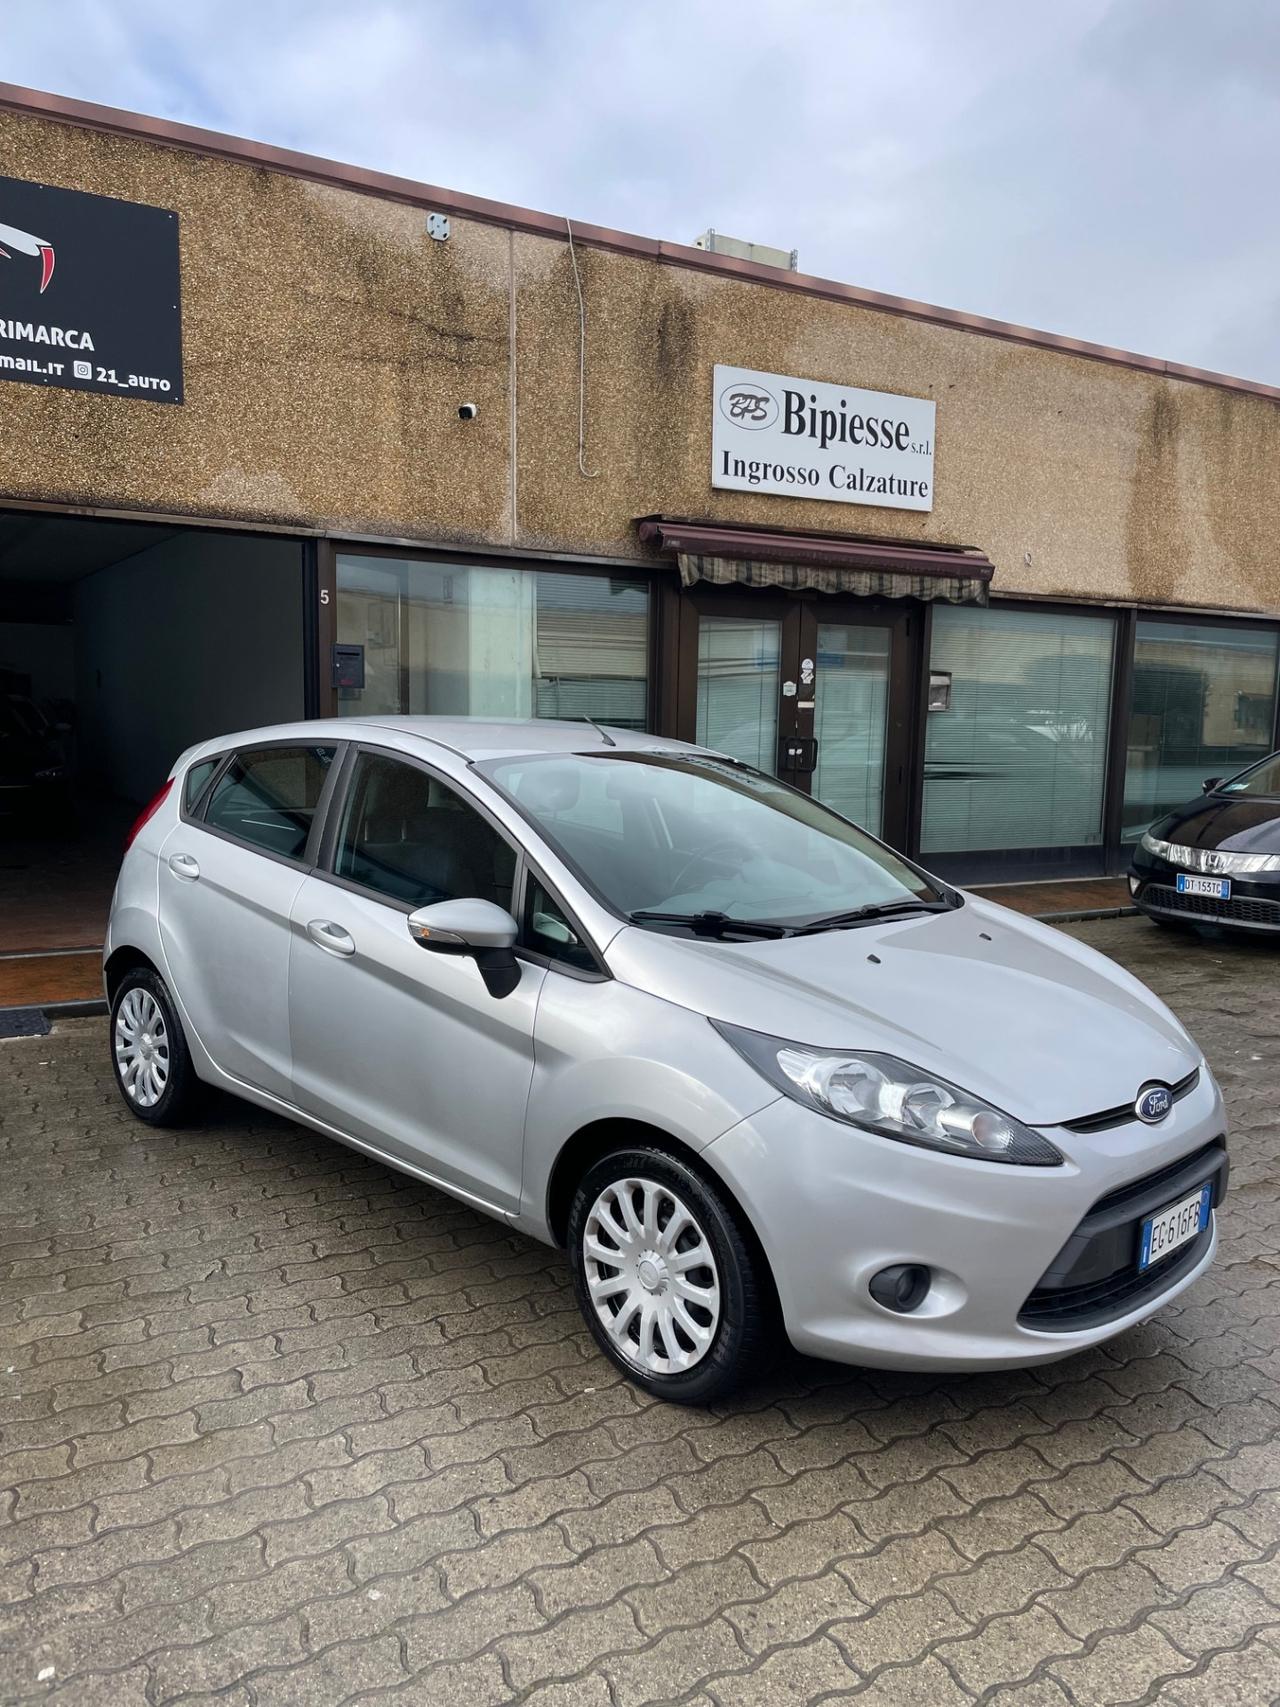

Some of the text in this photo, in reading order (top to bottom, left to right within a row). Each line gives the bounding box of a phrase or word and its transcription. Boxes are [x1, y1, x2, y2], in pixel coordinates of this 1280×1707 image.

[0, 319, 95, 351] RIMARCA
[781, 389, 932, 456] Bipiesse s.r.l.
[721, 450, 928, 498] Ingrosso Calzature
[320, 589, 330, 605] 5
[1148, 1092, 1169, 1115] Ford
